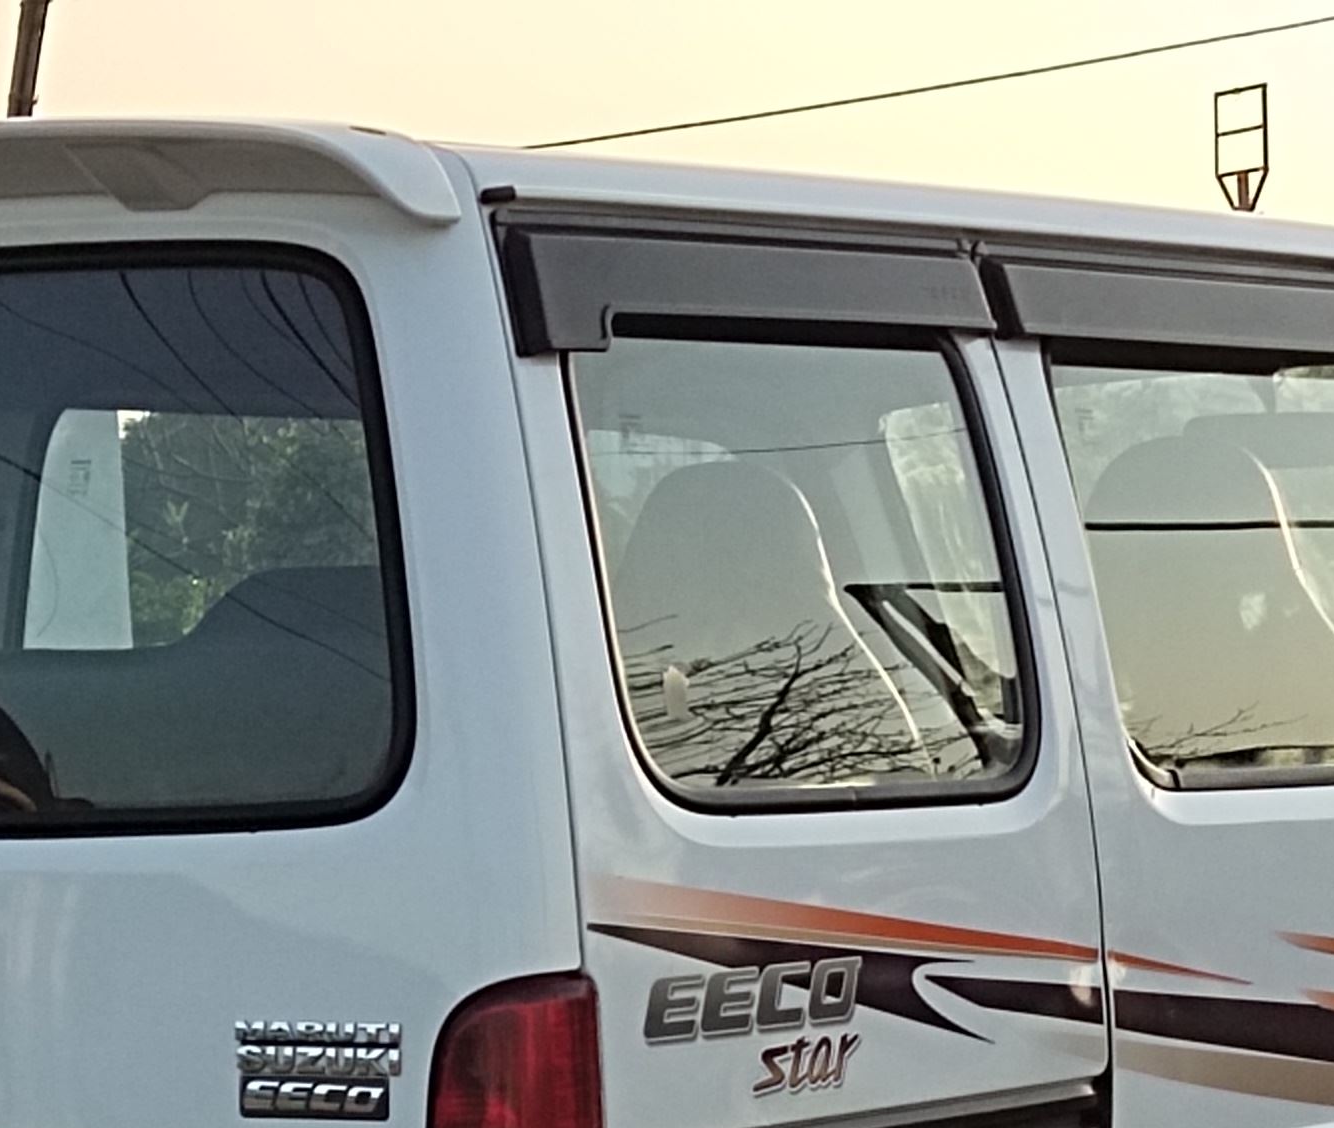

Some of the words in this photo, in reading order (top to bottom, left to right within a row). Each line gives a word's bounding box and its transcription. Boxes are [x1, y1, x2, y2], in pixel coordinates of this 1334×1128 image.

[644, 956, 862, 1043] EECO
[235, 1021, 402, 1044] MARUTI
[237, 1045, 402, 1076] SUZUKI
[752, 1032, 860, 1096] star
[243, 1080, 385, 1114] EECO
